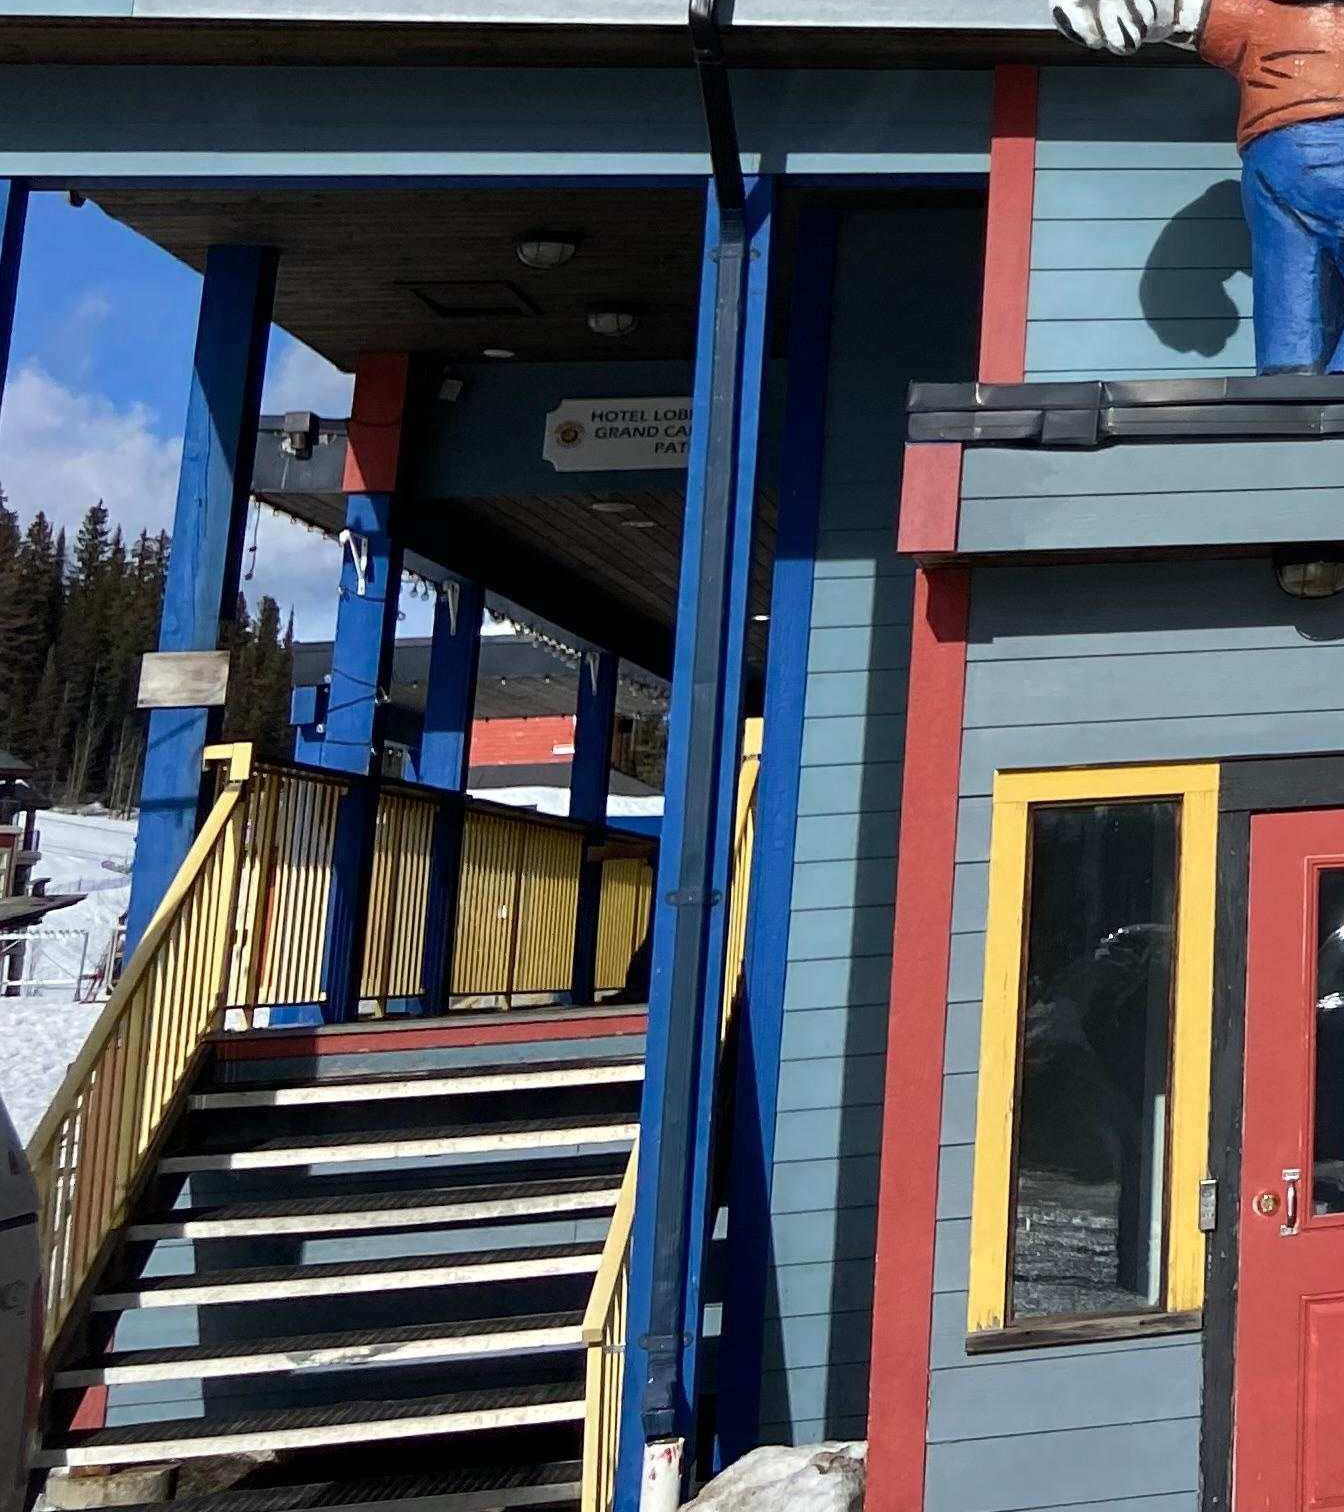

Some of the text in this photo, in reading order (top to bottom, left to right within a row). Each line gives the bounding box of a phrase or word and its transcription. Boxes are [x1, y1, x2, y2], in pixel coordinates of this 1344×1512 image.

[591, 408, 692, 423] HOTEL LOB
[594, 426, 659, 439] GRAND
[664, 425, 692, 438] CA
[654, 441, 690, 454] PAT
